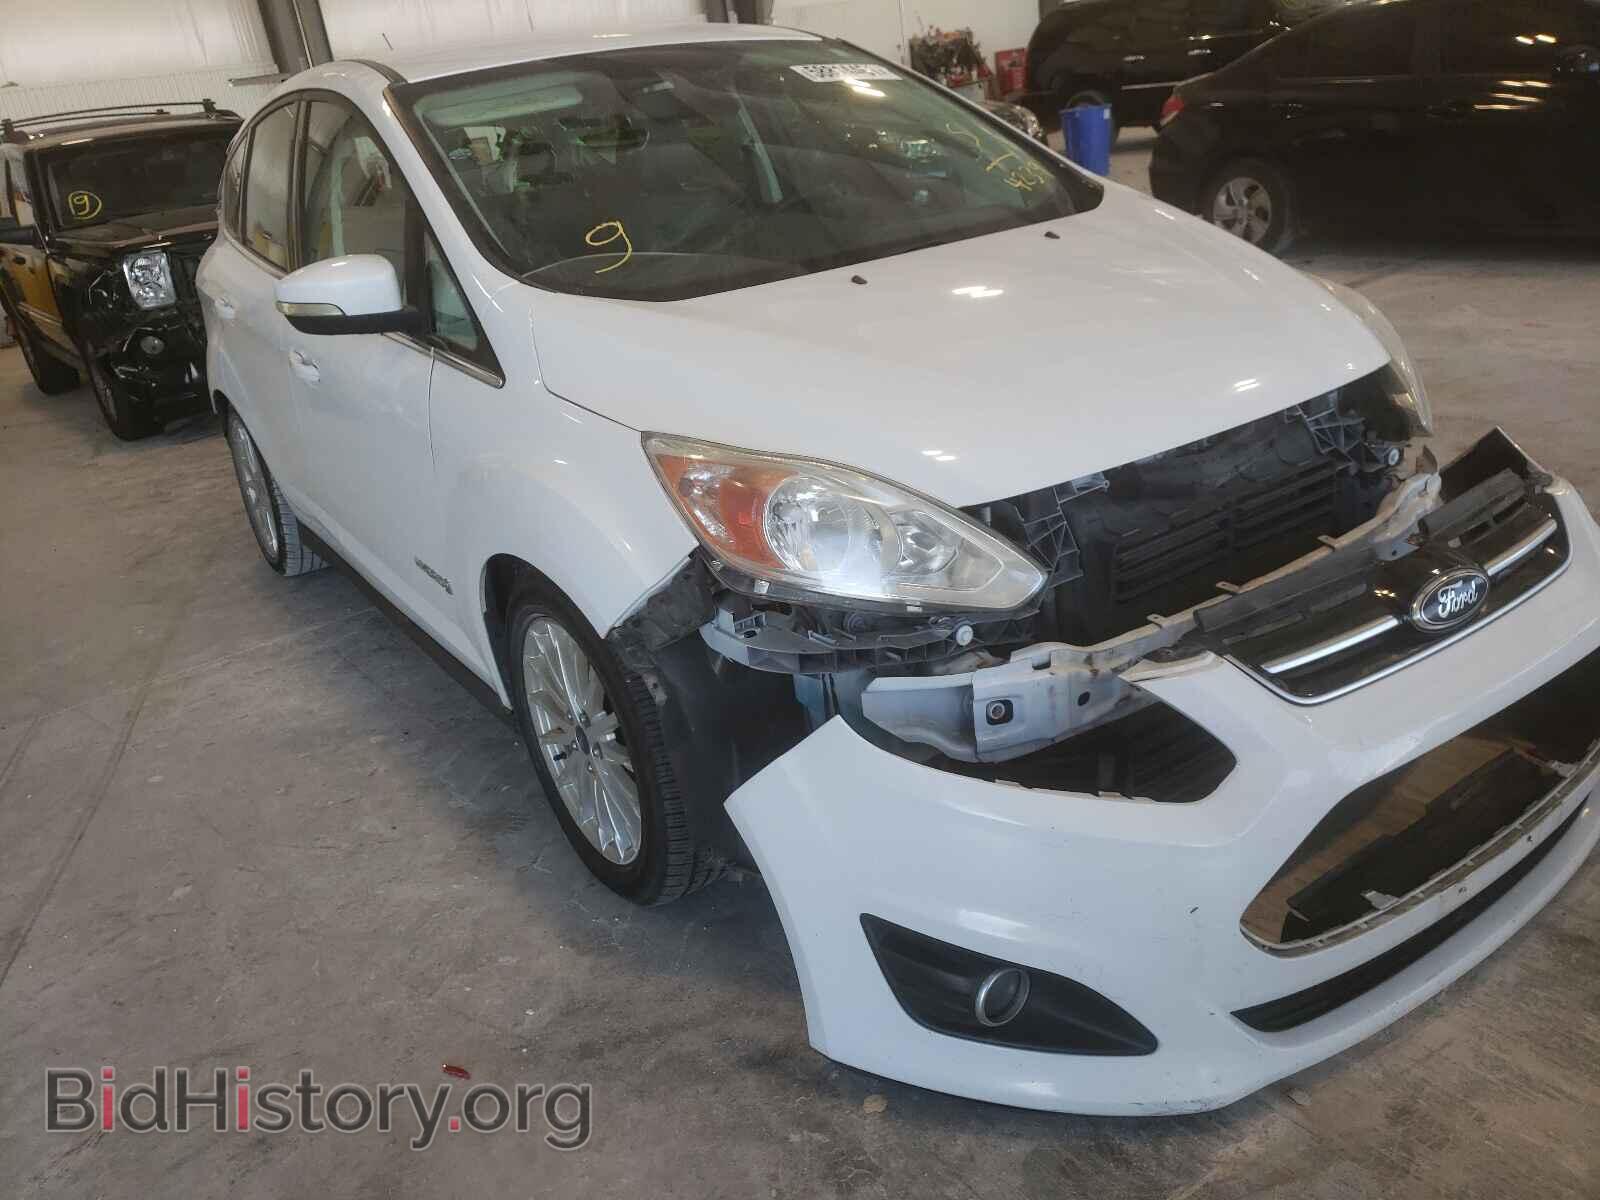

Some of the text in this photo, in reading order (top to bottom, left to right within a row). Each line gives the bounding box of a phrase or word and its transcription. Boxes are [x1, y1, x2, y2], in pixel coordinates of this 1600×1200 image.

[73, 194, 90, 216] 9
[585, 220, 633, 274] 9
[1438, 579, 1478, 618] Ford
